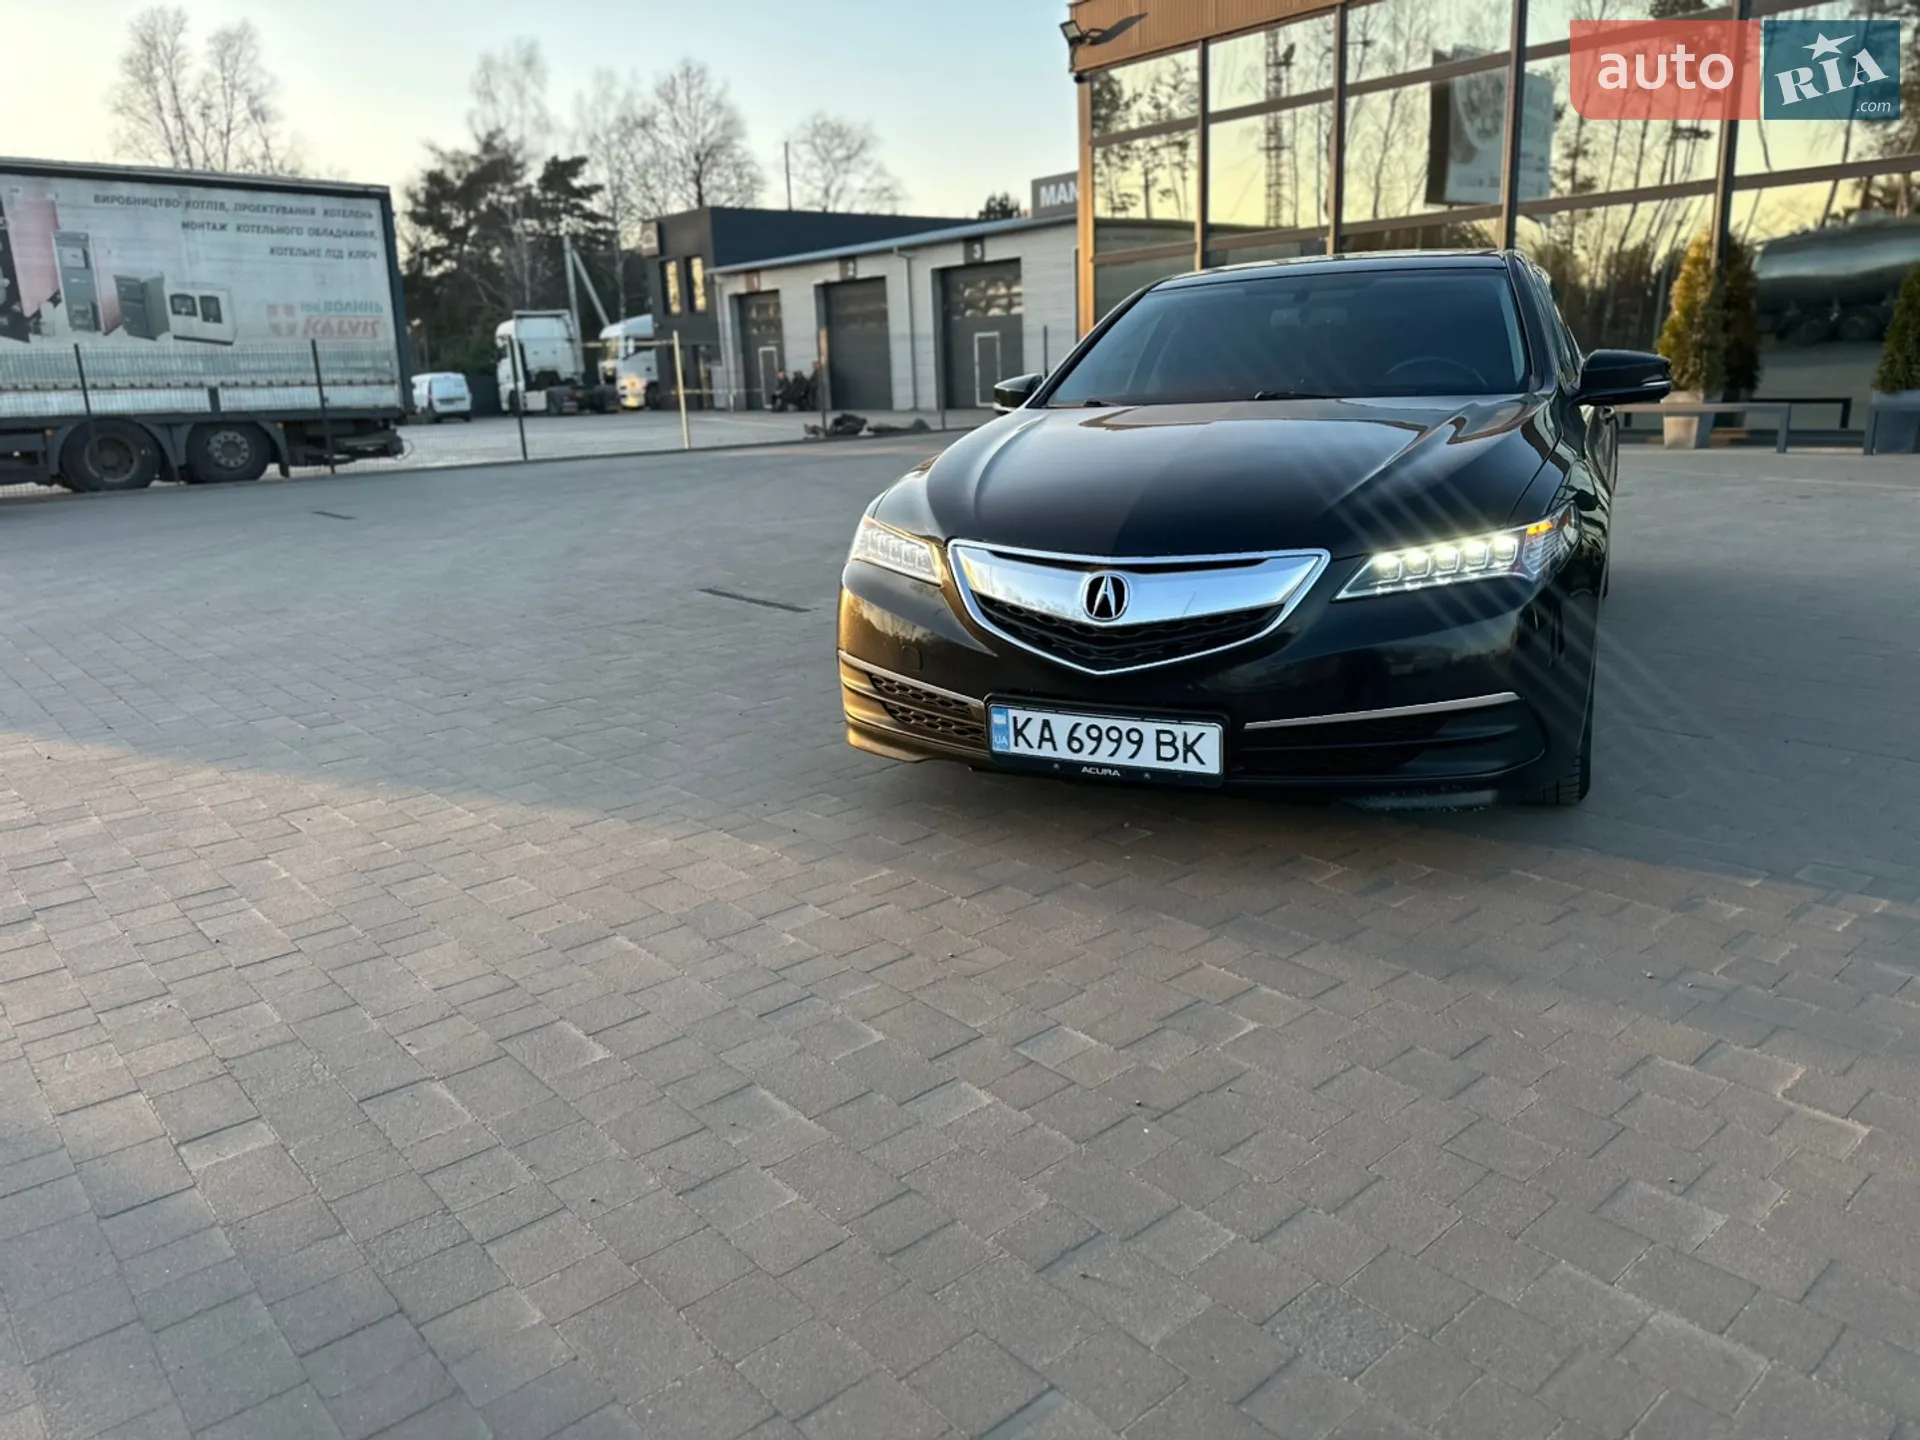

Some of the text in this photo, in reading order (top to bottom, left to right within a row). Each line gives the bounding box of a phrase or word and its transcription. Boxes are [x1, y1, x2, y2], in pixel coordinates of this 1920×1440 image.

[93, 194, 180, 209] ВИРОБНИЦТВО
[322, 208, 374, 220] КОТЕЛЕНЬ
[181, 221, 228, 232] МОНТАЖ
[235, 223, 303, 237] КОТЕЛЬНОГО
[347, 251, 377, 260] КЛЮЧ
[994, 734, 1009, 746] UA
[1012, 715, 1206, 766] KA 6999 BK
[1080, 766, 1121, 777] ACURA
